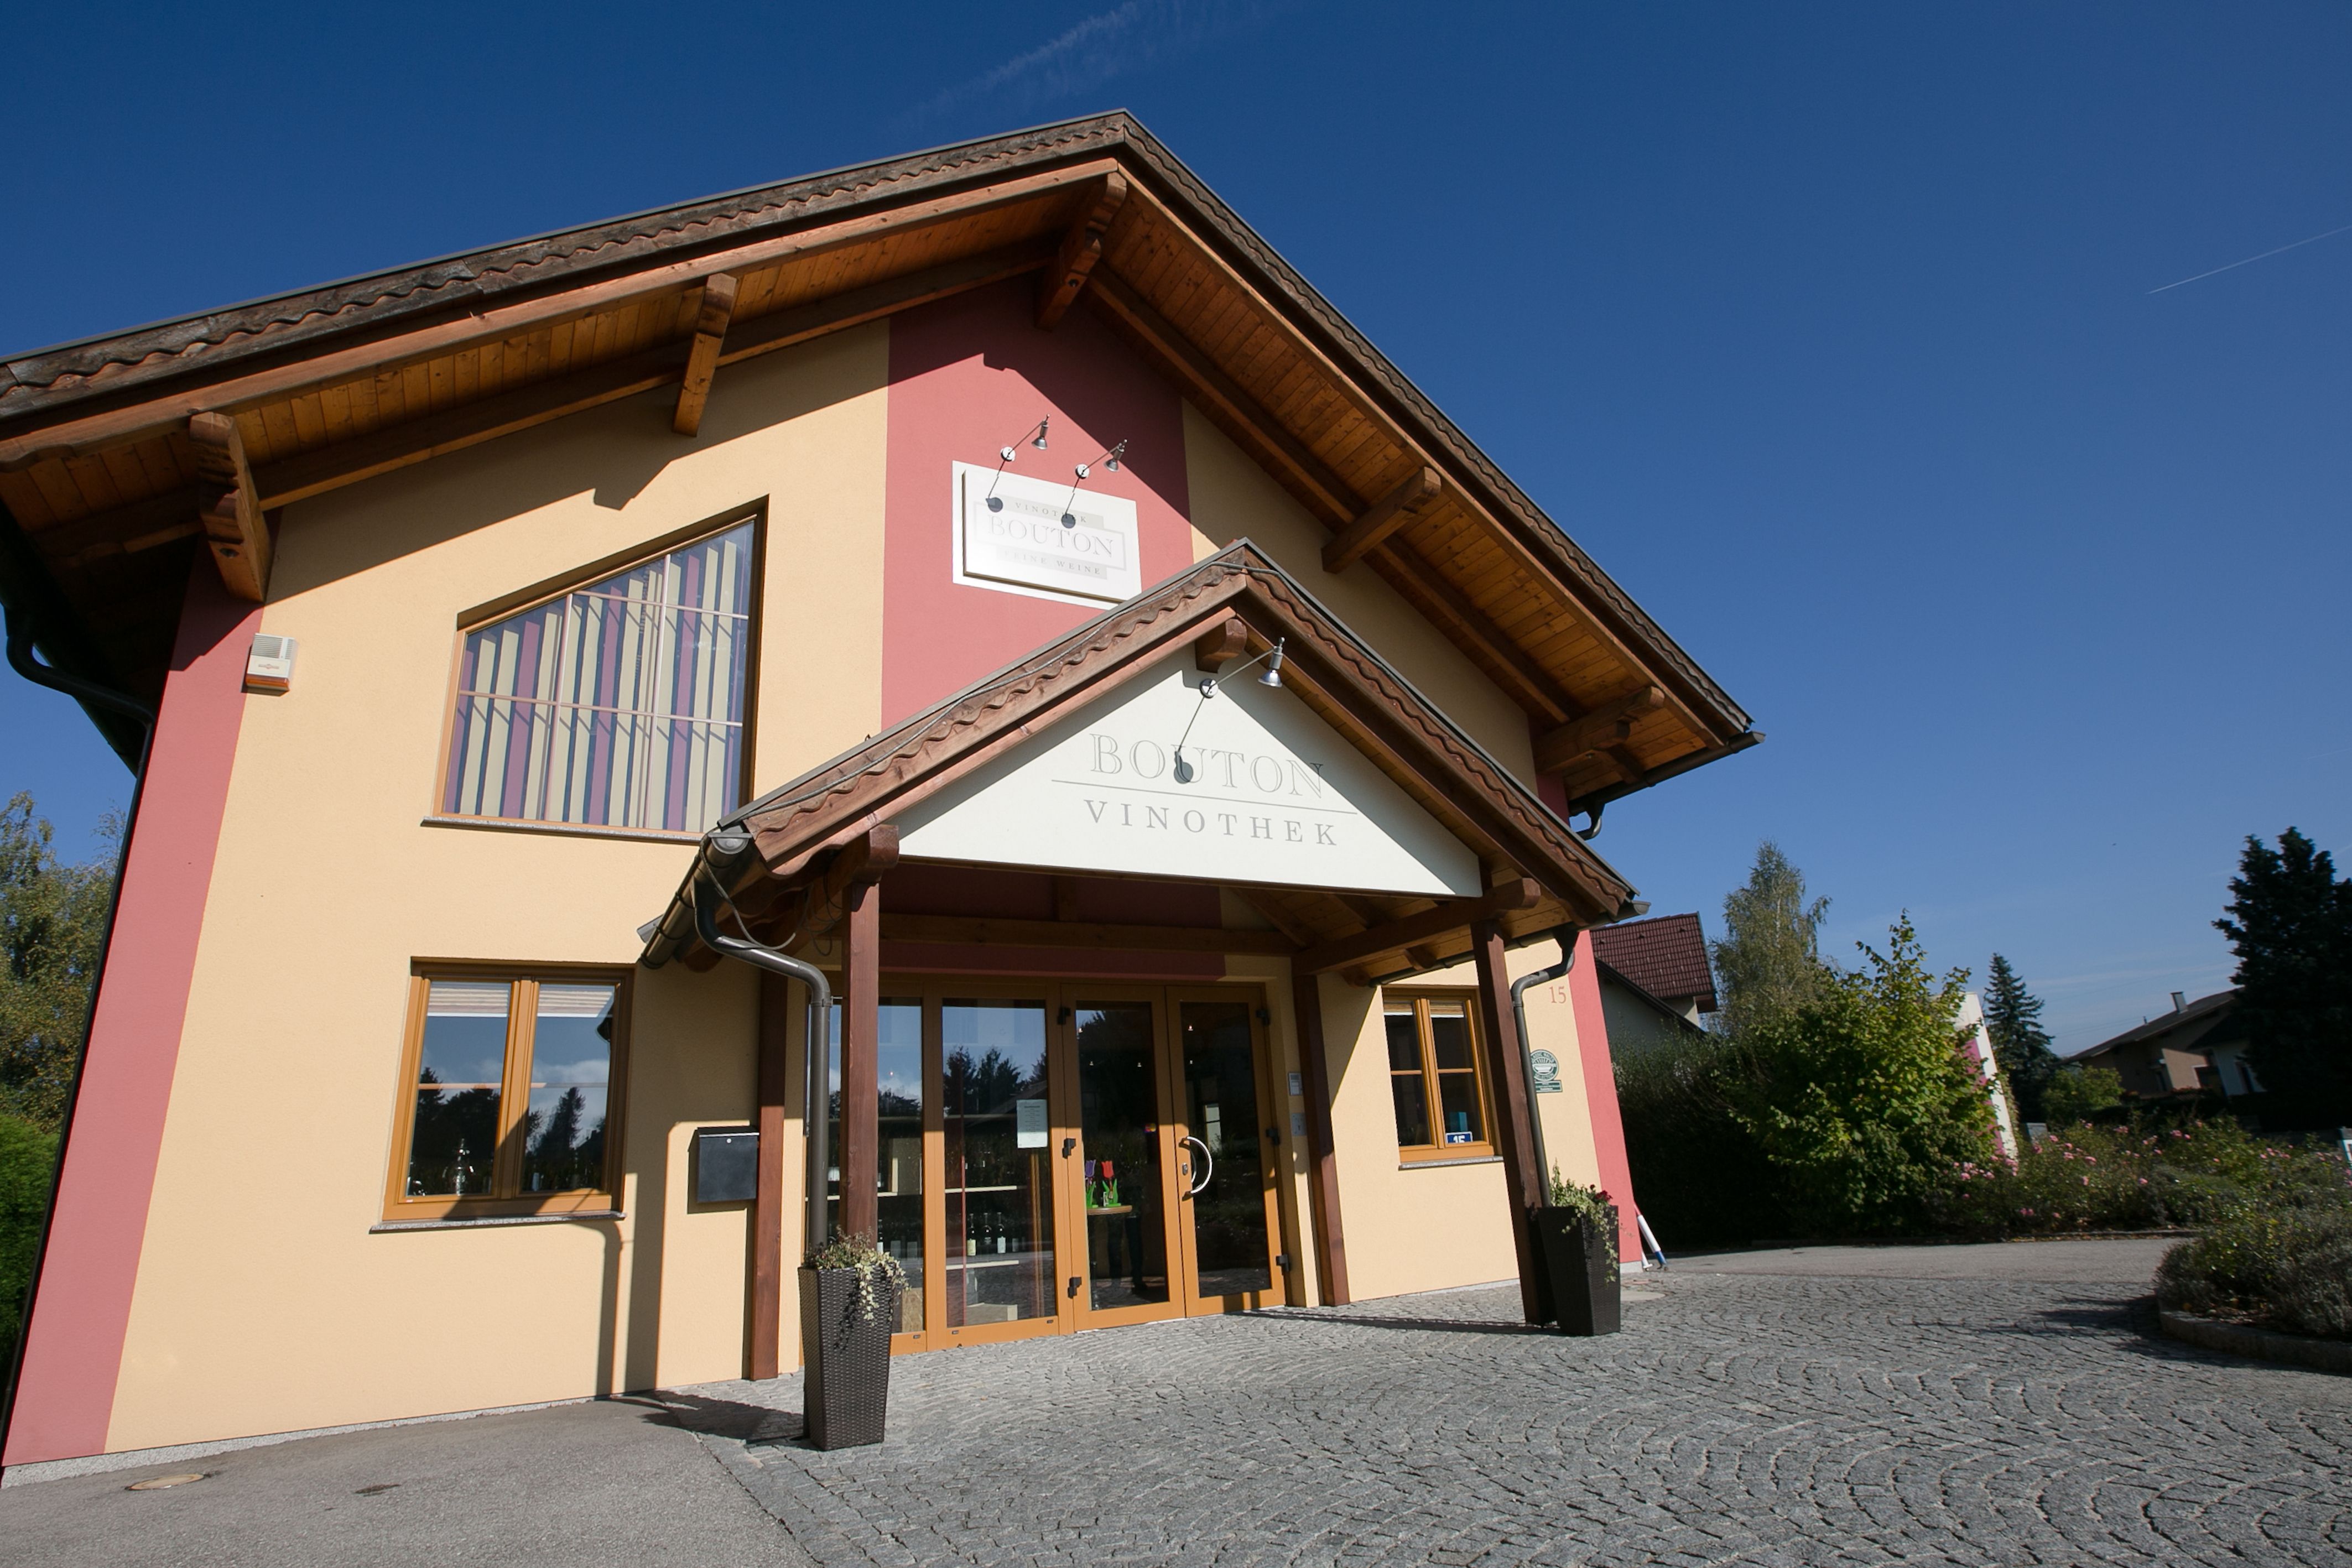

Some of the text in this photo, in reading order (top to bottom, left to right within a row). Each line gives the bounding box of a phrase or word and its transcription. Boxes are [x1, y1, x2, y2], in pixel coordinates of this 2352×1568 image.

[987, 514, 1114, 558] BOUTON
[1057, 560, 1100, 575] WEINE
[1089, 733, 1324, 799] BOUTON
[1084, 799, 1337, 846] VINOTHEK
[1549, 986, 1567, 1004] 15
